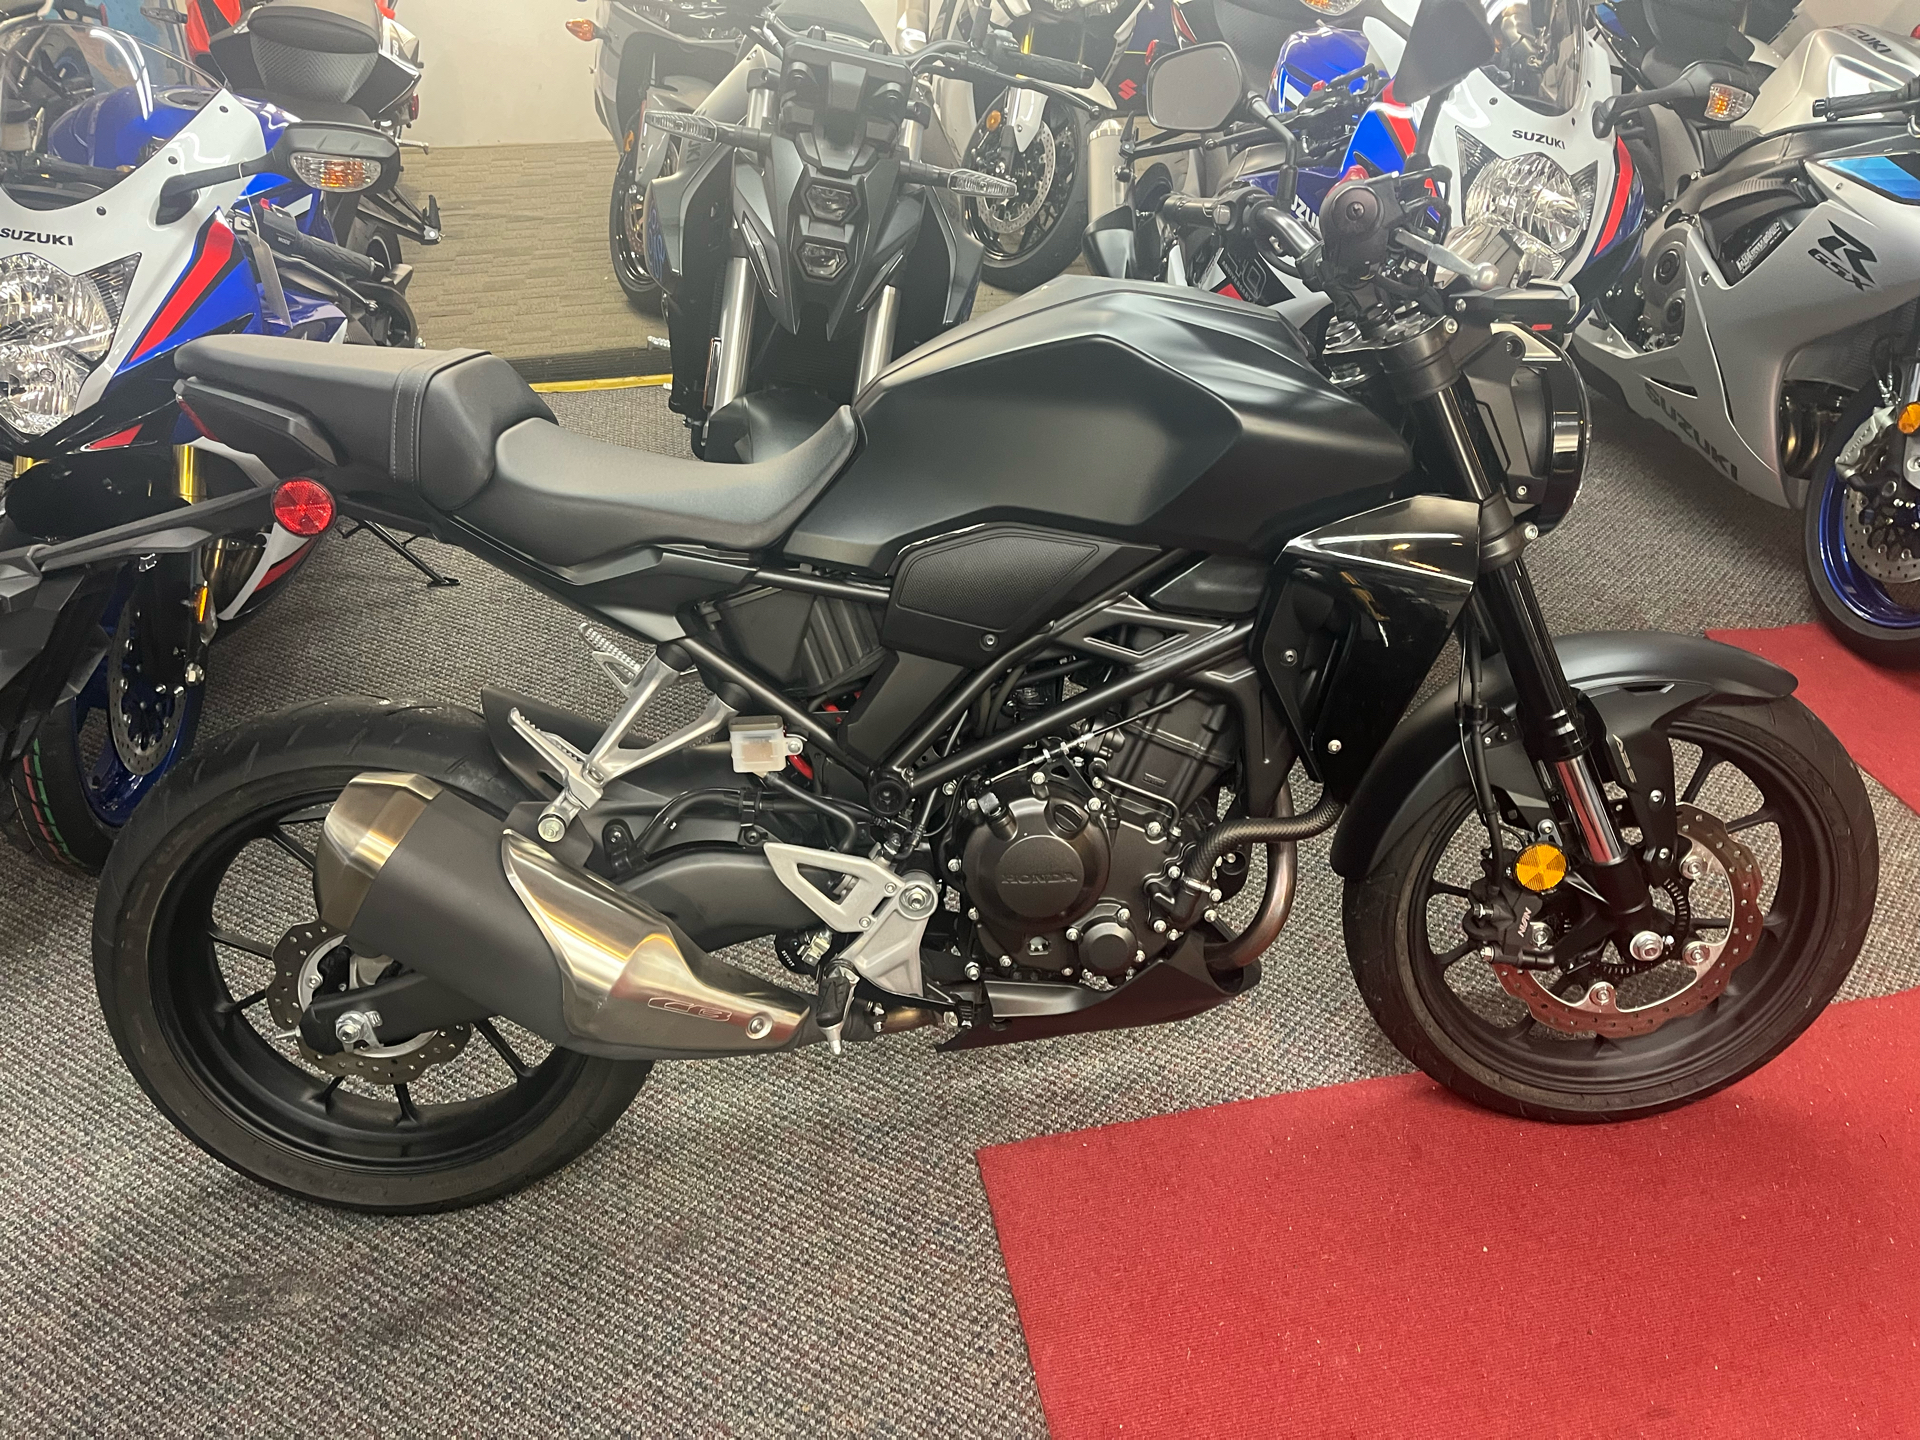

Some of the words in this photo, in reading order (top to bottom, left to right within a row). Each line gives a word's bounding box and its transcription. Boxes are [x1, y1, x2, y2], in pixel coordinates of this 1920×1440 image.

[1511, 129, 1566, 150] SUZUKI
[0, 227, 74, 246] SUZUKI
[1221, 260, 1253, 302] ANNIVERSARY
[1644, 382, 1738, 481] SUZUKI
[1612, 733, 1637, 783] ABS
[1001, 873, 1078, 885] HONDA
